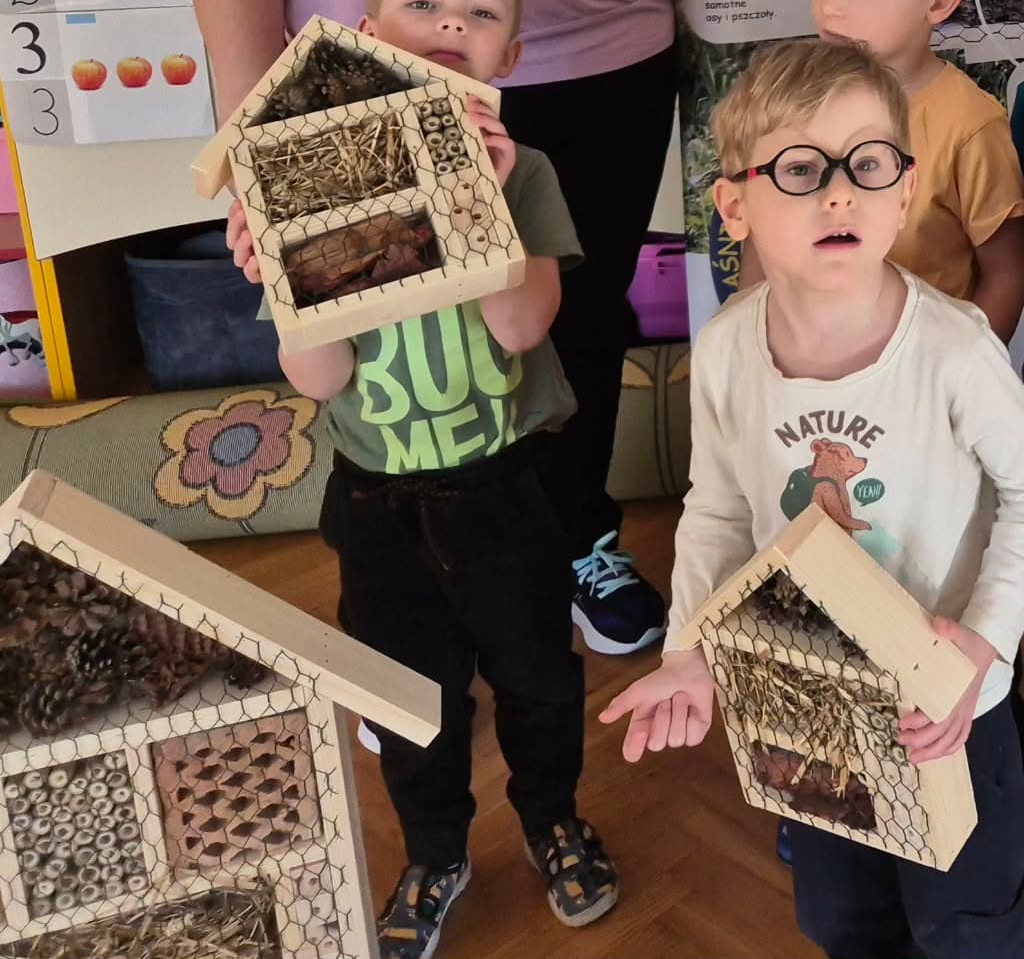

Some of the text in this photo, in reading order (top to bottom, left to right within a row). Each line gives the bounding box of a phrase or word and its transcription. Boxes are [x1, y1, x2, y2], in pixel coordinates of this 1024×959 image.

[704, 1, 746, 10] samotne
[11, 21, 47, 75] 3
[31, 87, 60, 136] 3
[774, 409, 886, 450] NATURE
[856, 483, 882, 498] YEAH!
